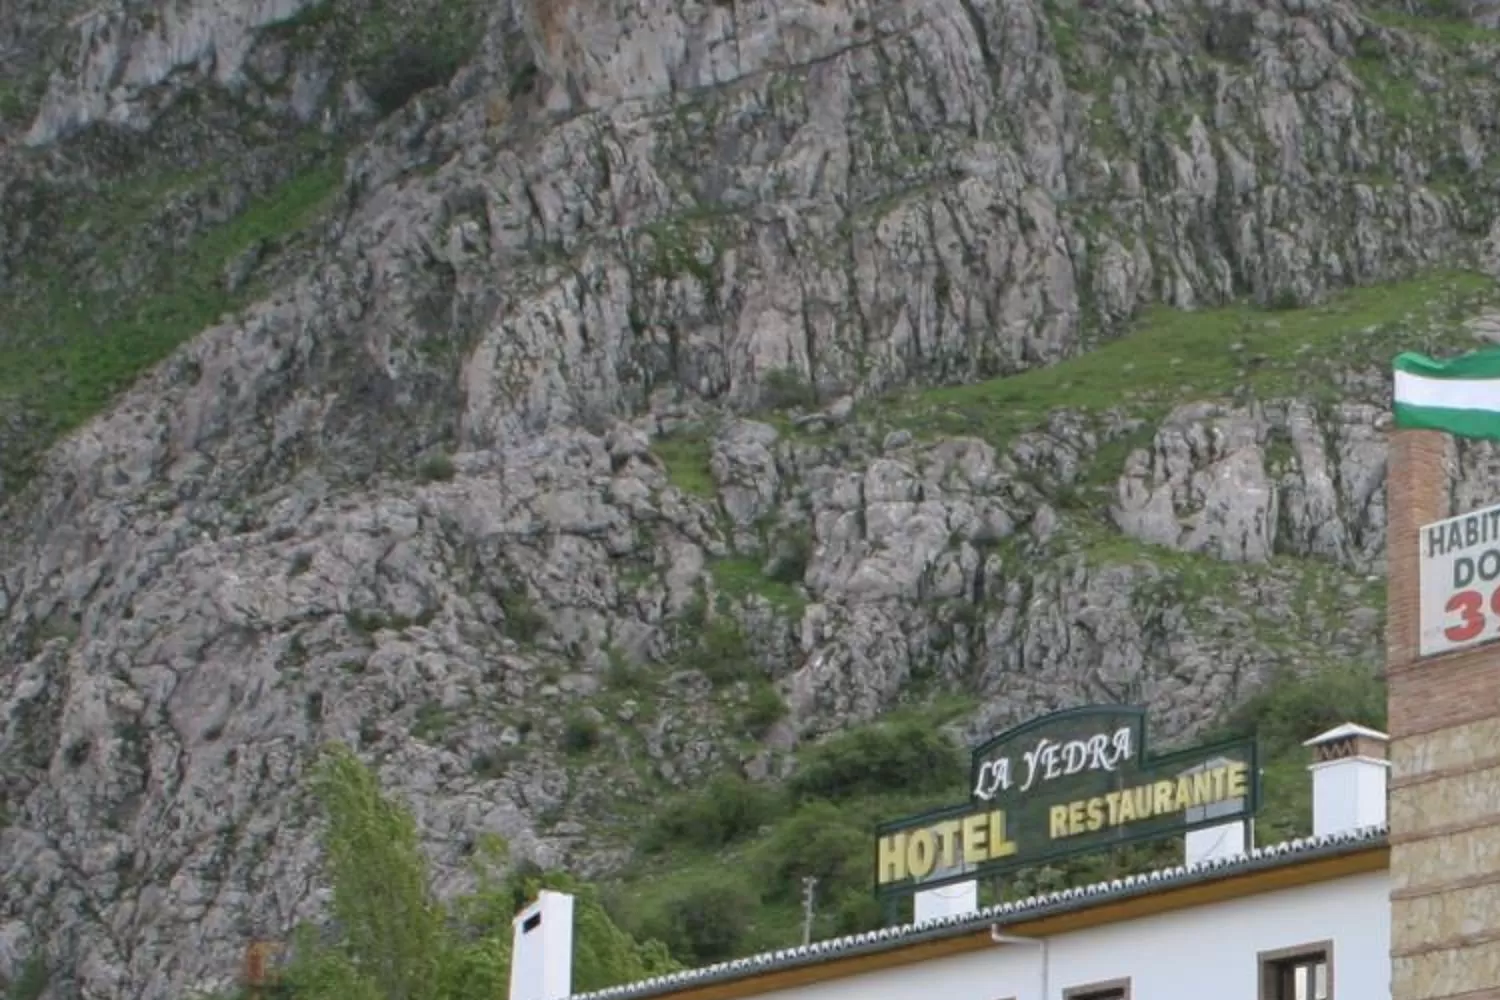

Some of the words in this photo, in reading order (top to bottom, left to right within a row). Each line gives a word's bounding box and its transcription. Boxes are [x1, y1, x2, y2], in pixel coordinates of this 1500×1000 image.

[973, 758, 1013, 801] LA
[1019, 727, 1133, 793] YEDRA
[877, 809, 1018, 884] HOTEL
[1049, 760, 1250, 839] RESTAURANTE
